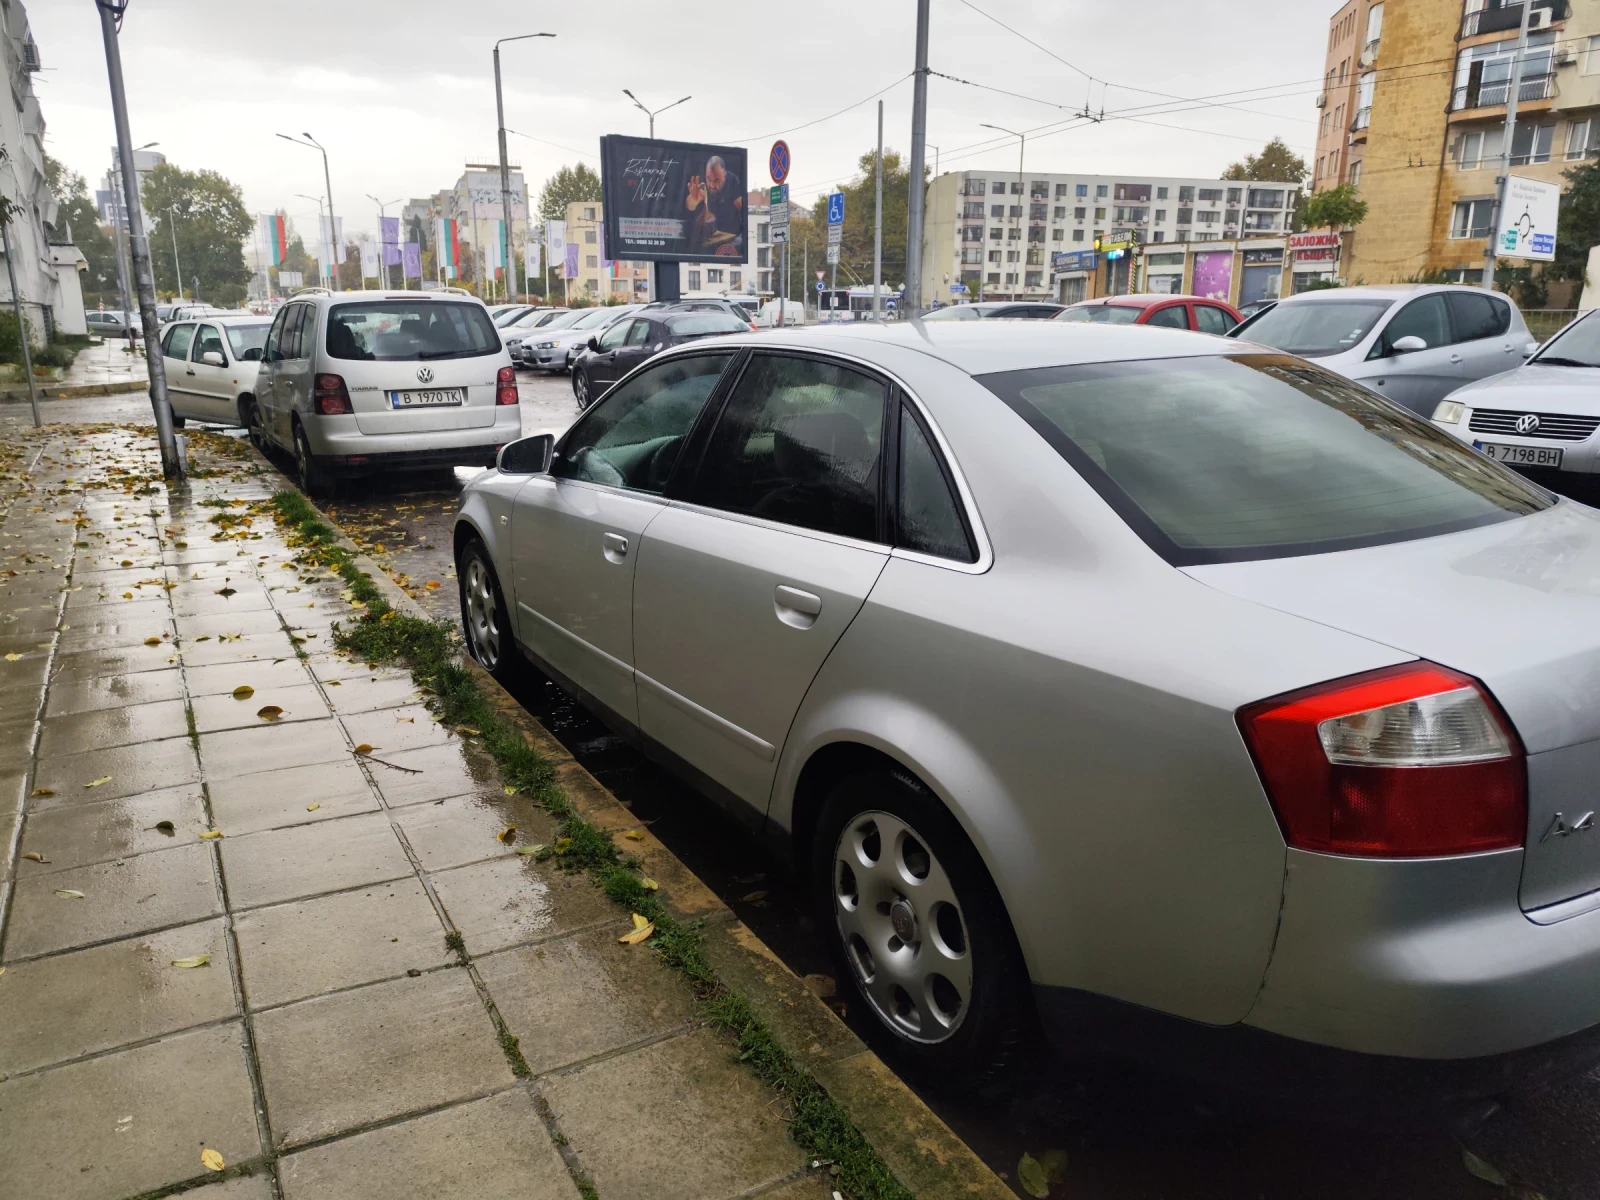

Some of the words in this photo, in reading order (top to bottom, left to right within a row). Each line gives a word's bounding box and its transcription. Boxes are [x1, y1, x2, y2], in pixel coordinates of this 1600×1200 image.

[632, 177, 666, 202] Nikola
[1290, 234, 1338, 248] ЗАЛОЖНА
[417, 392, 443, 403] 1970
[1502, 448, 1535, 462] 7198
